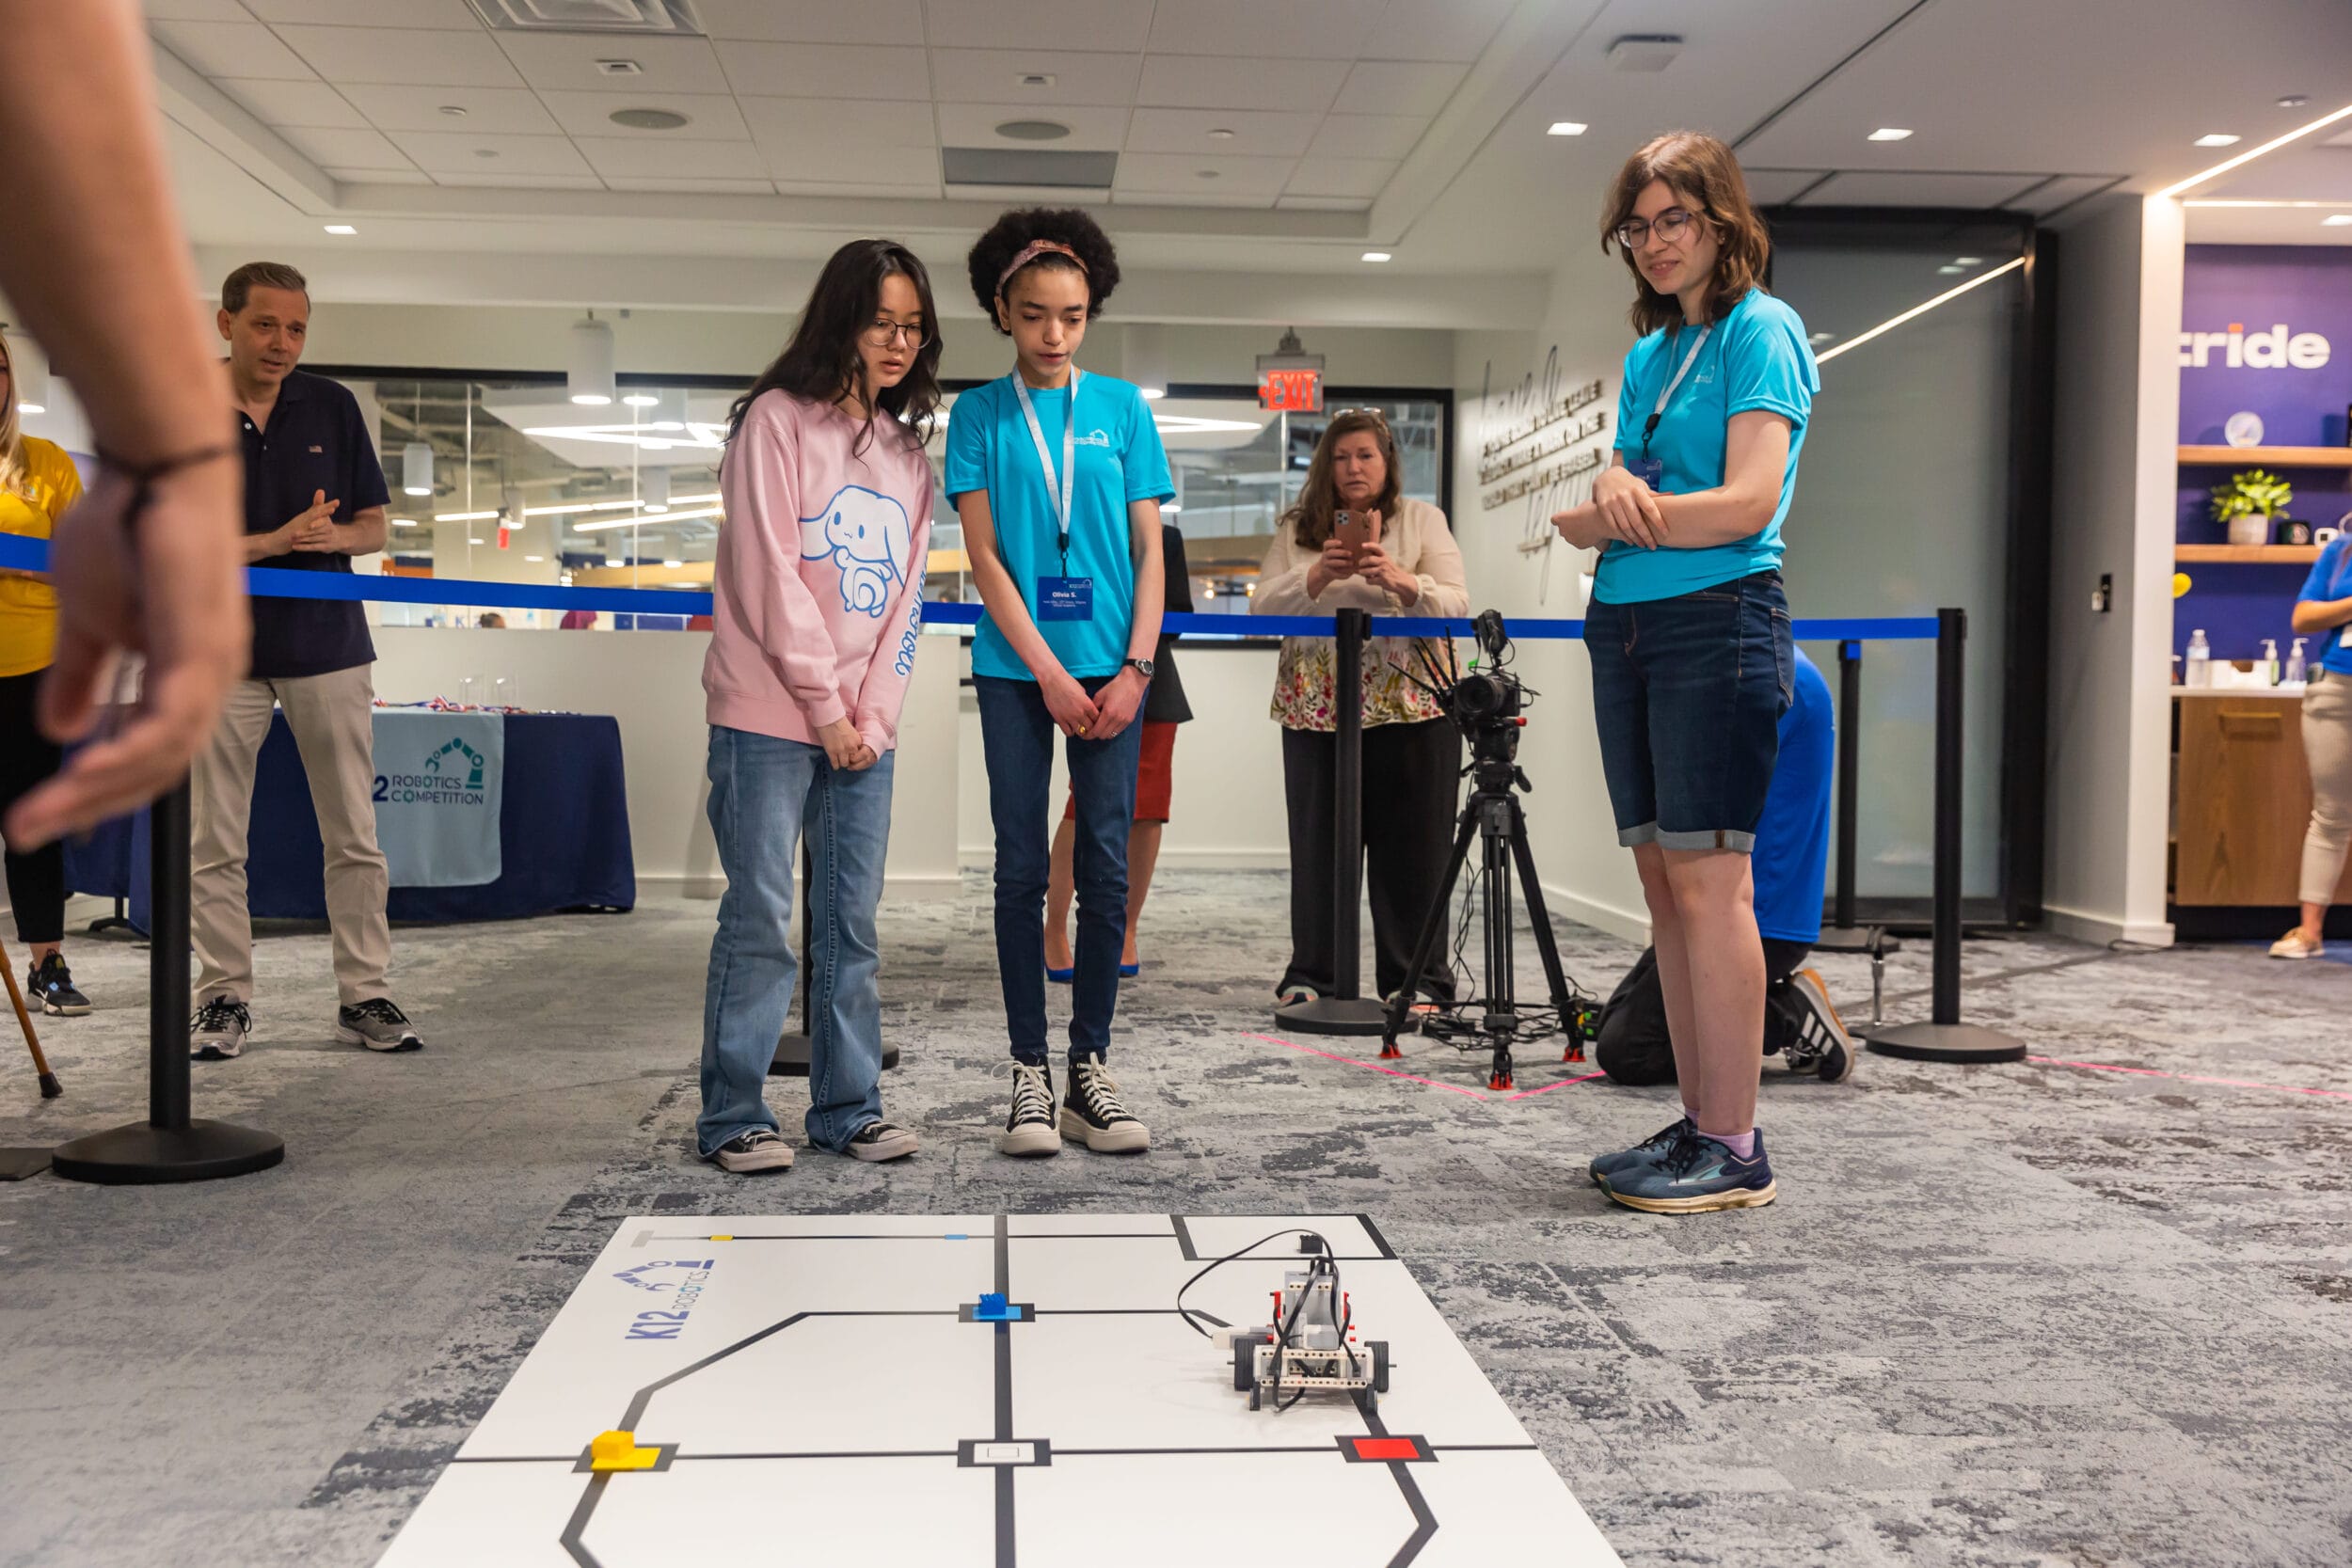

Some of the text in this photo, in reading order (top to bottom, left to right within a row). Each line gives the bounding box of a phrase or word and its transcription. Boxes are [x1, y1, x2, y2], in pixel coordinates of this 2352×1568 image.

[1267, 370, 1316, 410] EXIT
[392, 775, 461, 789] ROBOTICS
[625, 1271, 710, 1339] K12 ROBOTICS
